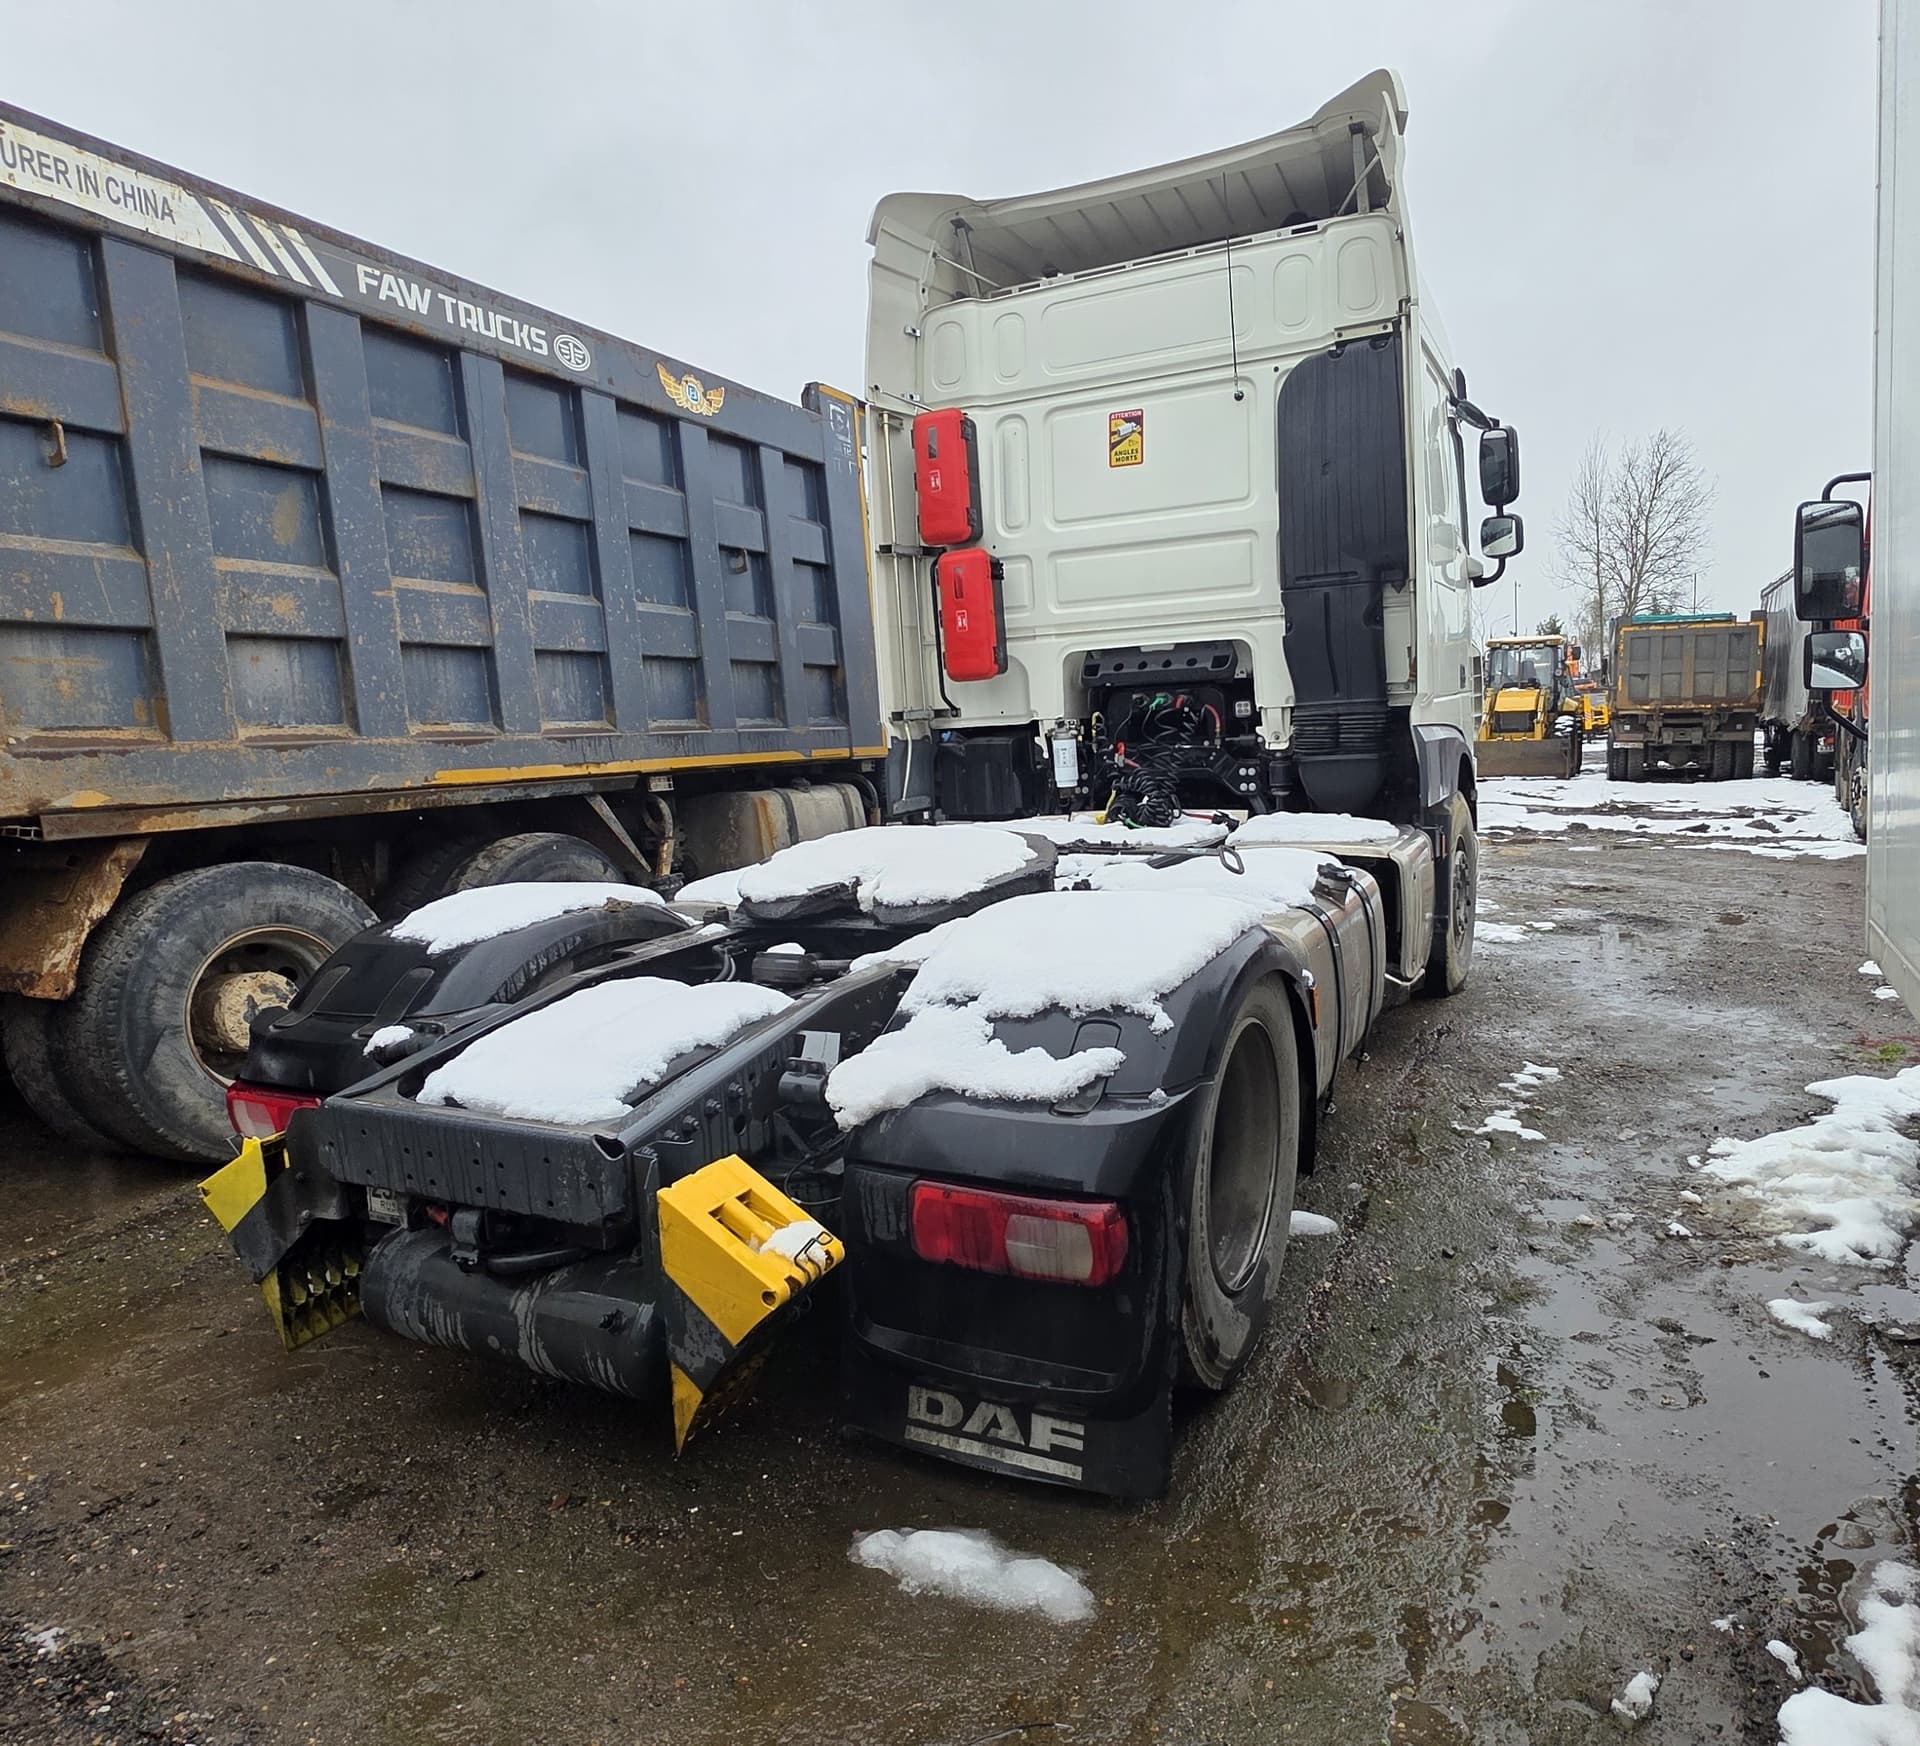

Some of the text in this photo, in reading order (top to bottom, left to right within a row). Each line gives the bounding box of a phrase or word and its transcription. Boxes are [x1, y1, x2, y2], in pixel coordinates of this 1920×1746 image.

[76, 163, 100, 199] IN
[105, 176, 176, 225] CHINA
[356, 263, 548, 356] FAW TRUCKS
[907, 1385, 1085, 1452] DAF
